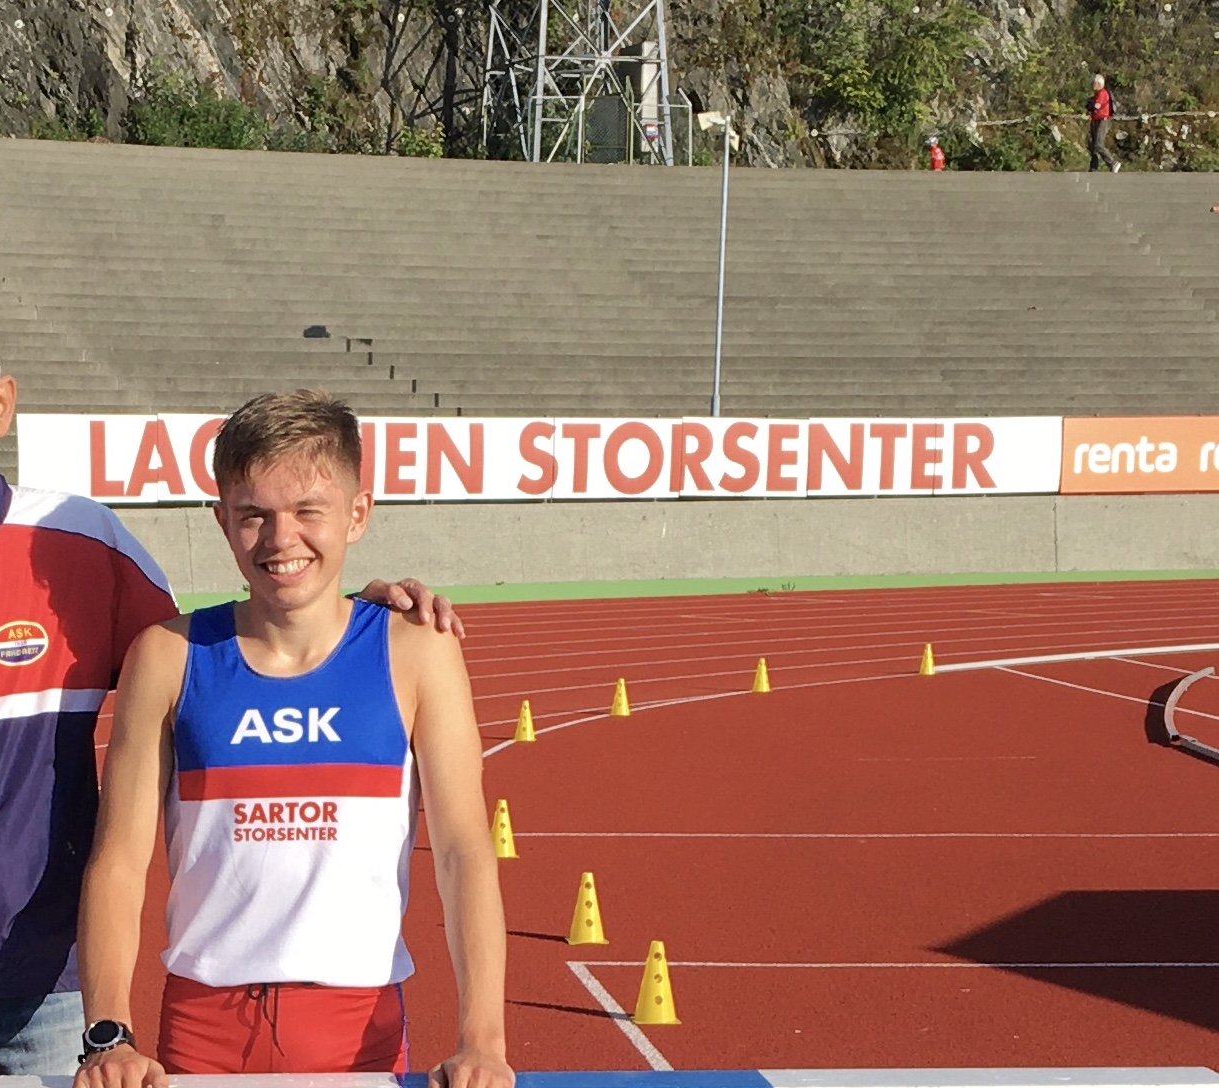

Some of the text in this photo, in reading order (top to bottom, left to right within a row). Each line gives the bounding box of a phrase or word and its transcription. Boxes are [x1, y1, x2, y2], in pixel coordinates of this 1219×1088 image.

[89, 417, 997, 497] LAEN STORSENTER
[1074, 436, 1219, 474] renta r
[8, 627, 32, 639] ASK
[230, 707, 342, 744] ASK
[233, 801, 338, 825] SARTOR
[233, 827, 338, 842] STORSENTER
